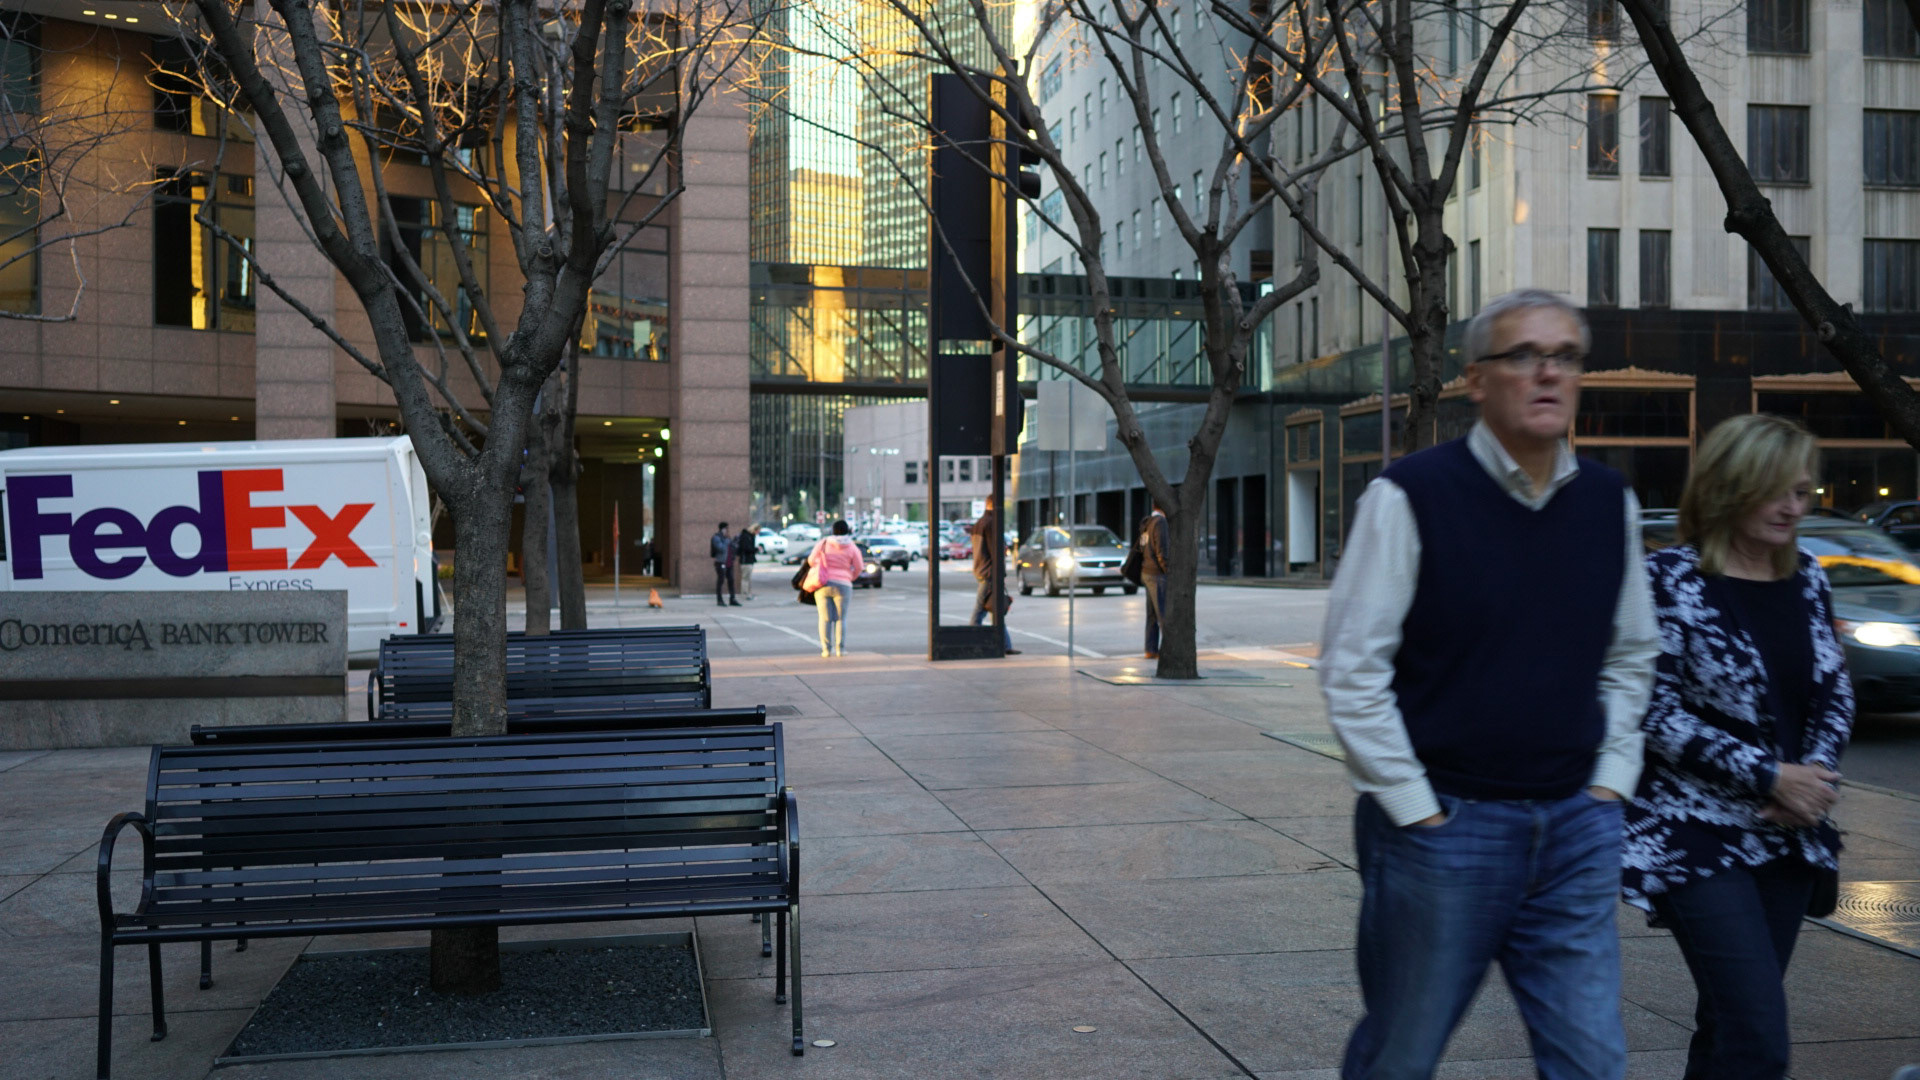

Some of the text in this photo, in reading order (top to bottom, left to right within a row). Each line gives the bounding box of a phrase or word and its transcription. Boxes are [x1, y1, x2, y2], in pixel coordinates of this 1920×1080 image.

[6, 468, 379, 580] FedEx
[161, 622, 235, 645] BANK
[237, 622, 329, 644] TOWER
